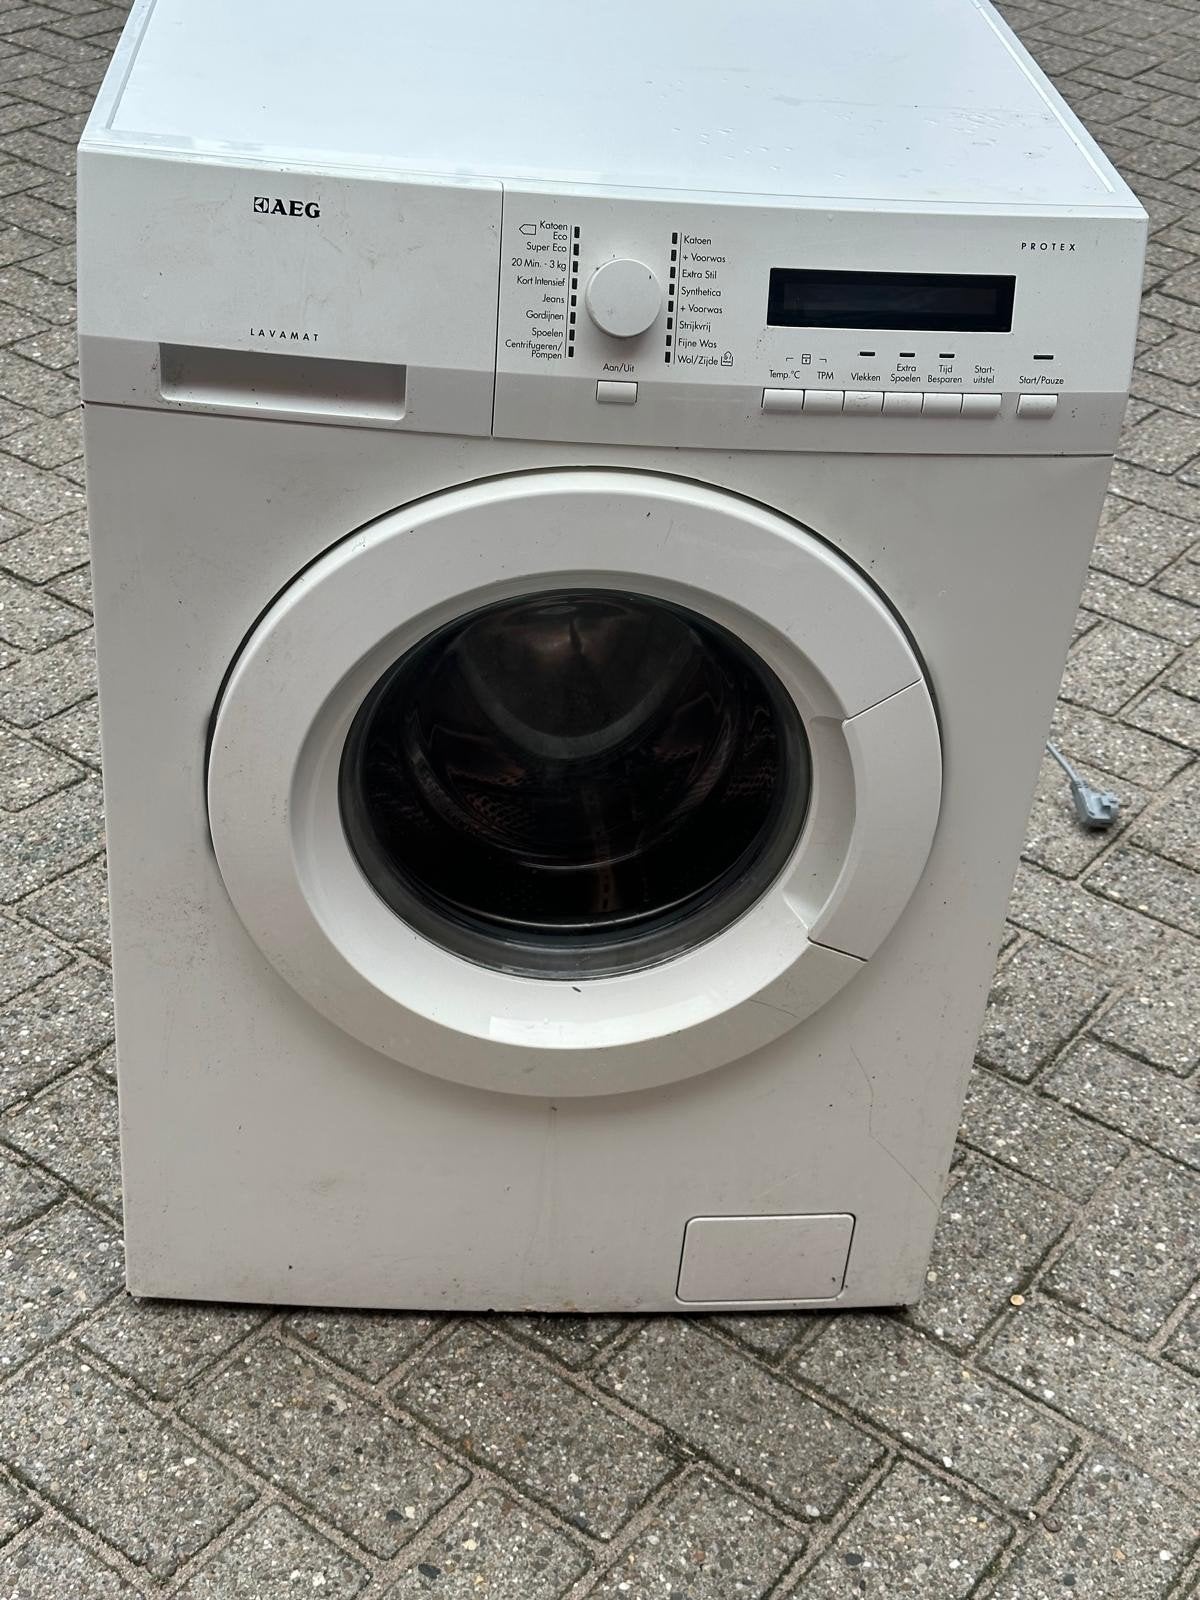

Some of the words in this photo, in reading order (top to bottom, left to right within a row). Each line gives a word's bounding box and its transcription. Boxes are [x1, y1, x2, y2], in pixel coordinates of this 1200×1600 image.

[271, 199, 321, 219] AEG
[540, 220, 568, 231] Katoen
[553, 231, 568, 240] Eco
[683, 235, 712, 245] Katoen
[526, 241, 550, 253] Super
[552, 243, 567, 252] Eco
[1021, 242, 1076, 252] PROTEX
[691, 252, 726, 263] Voorwas
[511, 257, 523, 267] 20
[524, 258, 541, 268] Min.
[549, 260, 555, 269] 3
[557, 260, 567, 272] kg
[682, 269, 703, 279] Extra
[704, 270, 717, 279] Stil
[516, 275, 533, 285] Kort
[534, 276, 565, 286] Intensief
[681, 286, 722, 297] Synthetica
[542, 293, 565, 304] Jeans
[688, 303, 723, 314] Voorwas
[525, 309, 564, 322] Gordijnen
[679, 320, 711, 332] Strijkvrij
[250, 328, 319, 342] LAVAMAT
[531, 327, 563, 338] Spoelen
[505, 339, 563, 352] Centrifugeren/
[678, 338, 697, 349] Fijne
[699, 339, 717, 348] Was
[531, 350, 562, 360] Pompen
[677, 354, 719, 367] Wol/Zijde
[603, 362, 635, 373] Aan/Uit
[896, 363, 917, 373] Extra
[938, 364, 953, 374] Tijd
[974, 365, 995, 374] Start-
[817, 371, 834, 380] TPM
[850, 371, 881, 382] Vlekken
[890, 373, 921, 384] Spoelen
[927, 375, 963, 385] Besparen
[973, 375, 995, 384] uitstel
[1018, 375, 1065, 385] Start/Pauze
